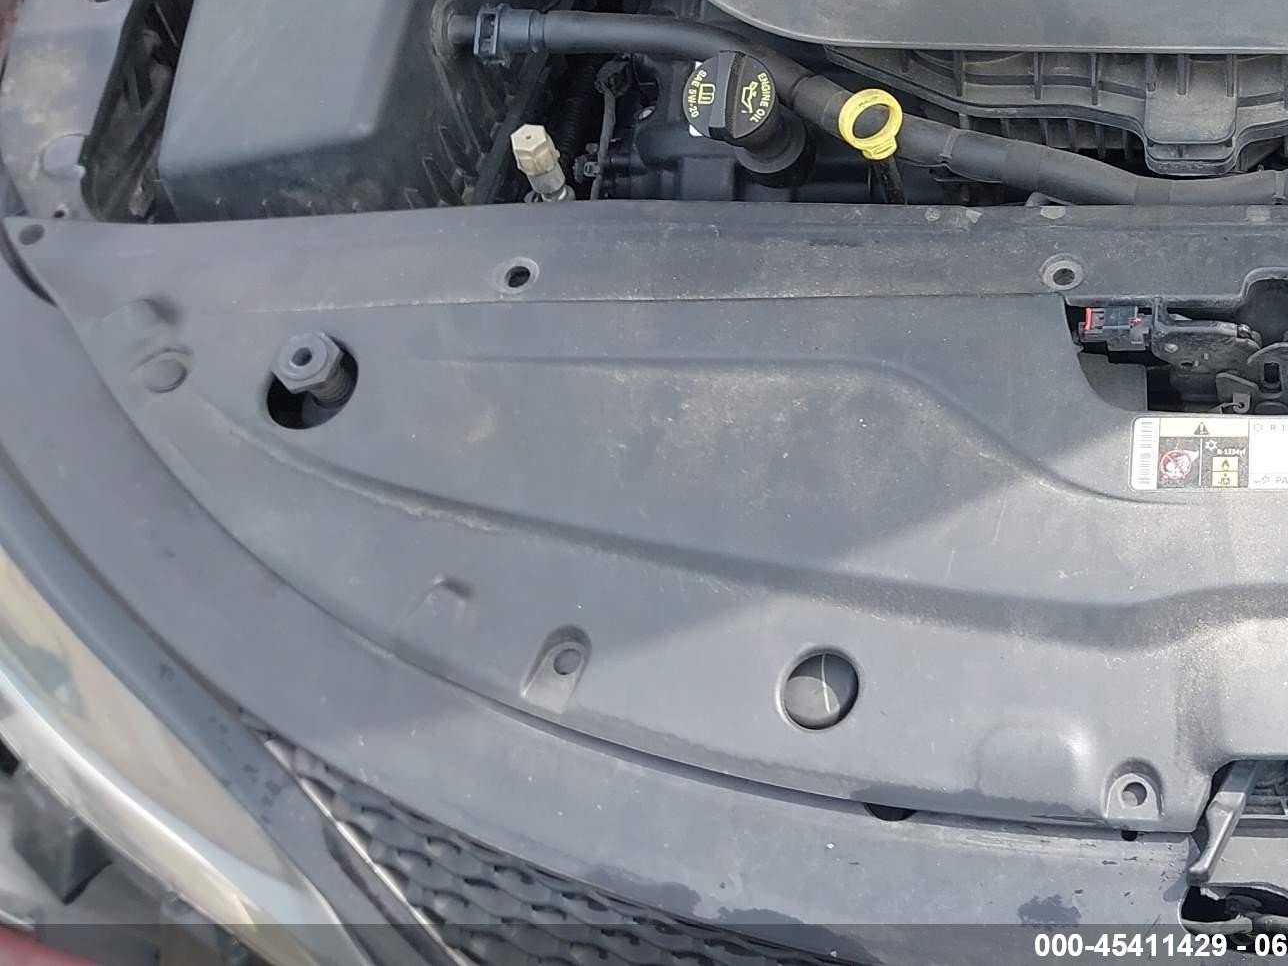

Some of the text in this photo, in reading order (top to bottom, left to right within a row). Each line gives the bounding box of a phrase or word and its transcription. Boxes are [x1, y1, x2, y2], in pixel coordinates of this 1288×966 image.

[688, 70, 707, 118] SAE 5W-20
[750, 73, 771, 123] ENGINE OIL
